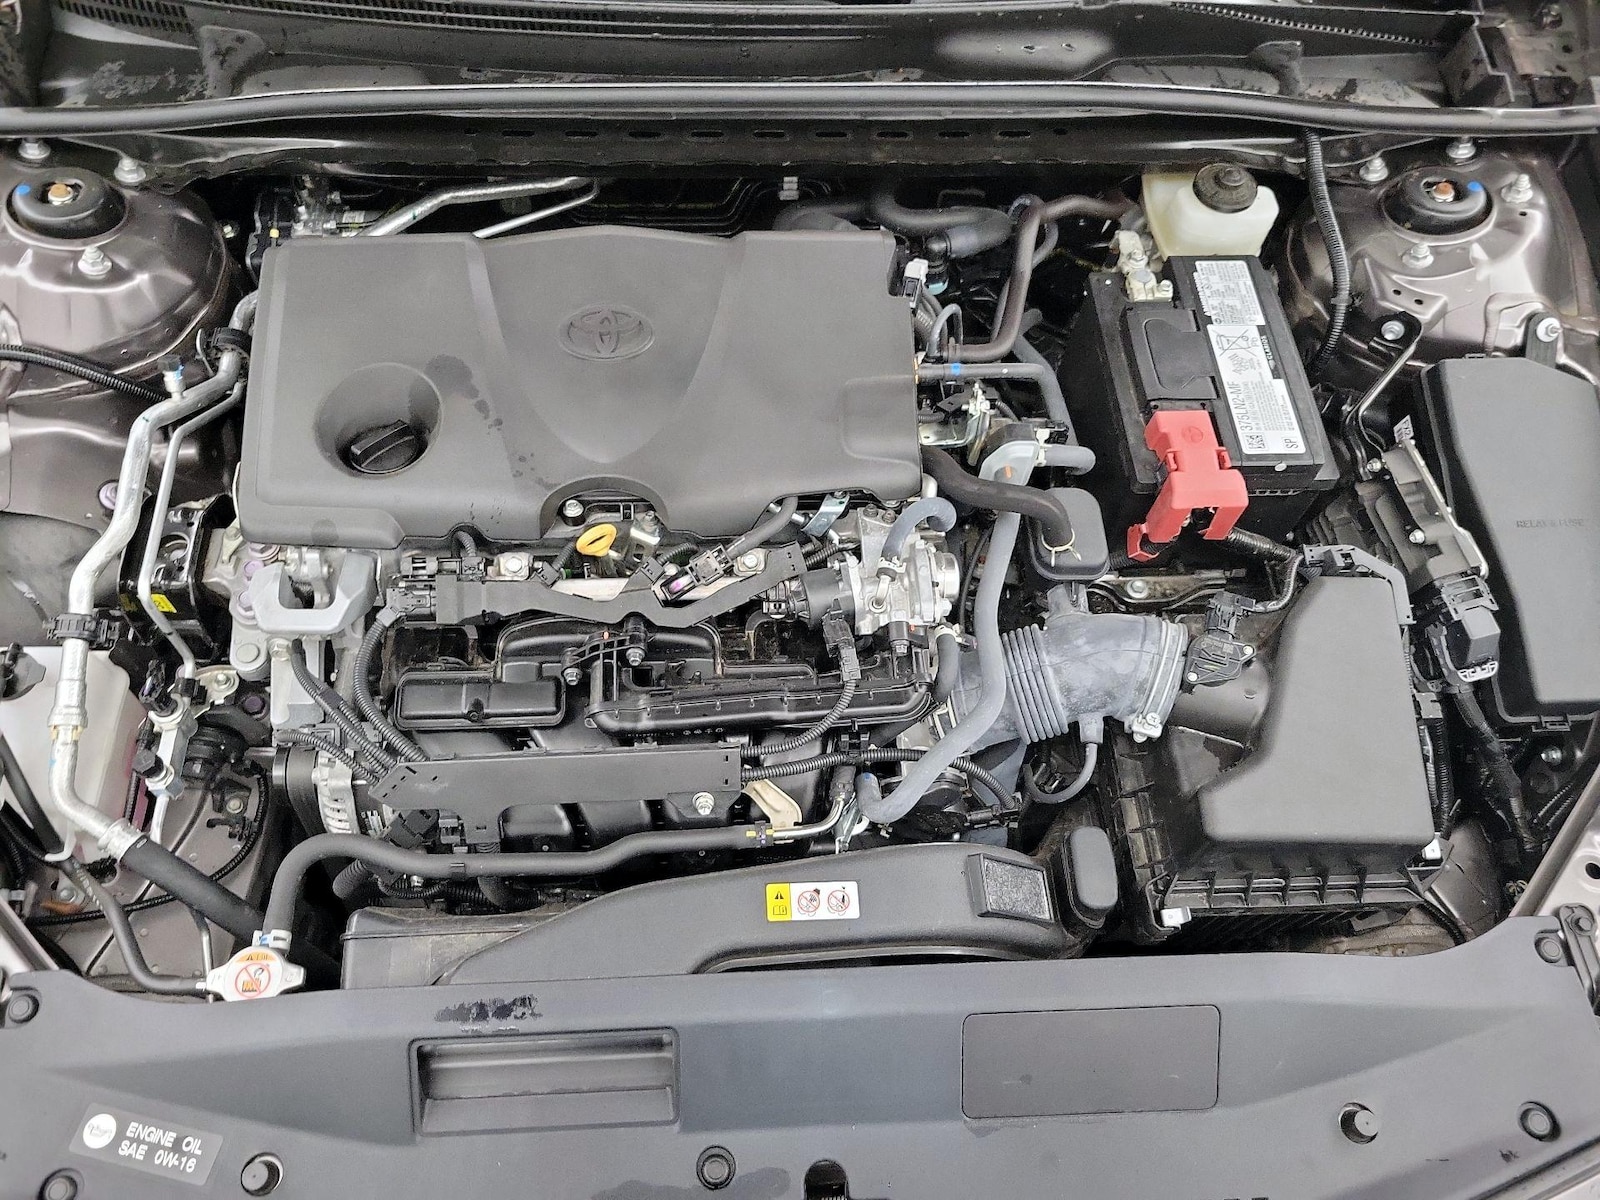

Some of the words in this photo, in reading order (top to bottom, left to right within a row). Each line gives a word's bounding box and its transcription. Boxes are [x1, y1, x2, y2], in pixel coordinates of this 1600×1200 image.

[1227, 381, 1253, 431] 375LN2-MF
[1284, 438, 1299, 449] SP
[126, 1122, 177, 1147] ENGINE
[182, 1136, 203, 1155] OIL
[118, 1140, 148, 1160] SAE
[154, 1149, 196, 1173] 0W-16
